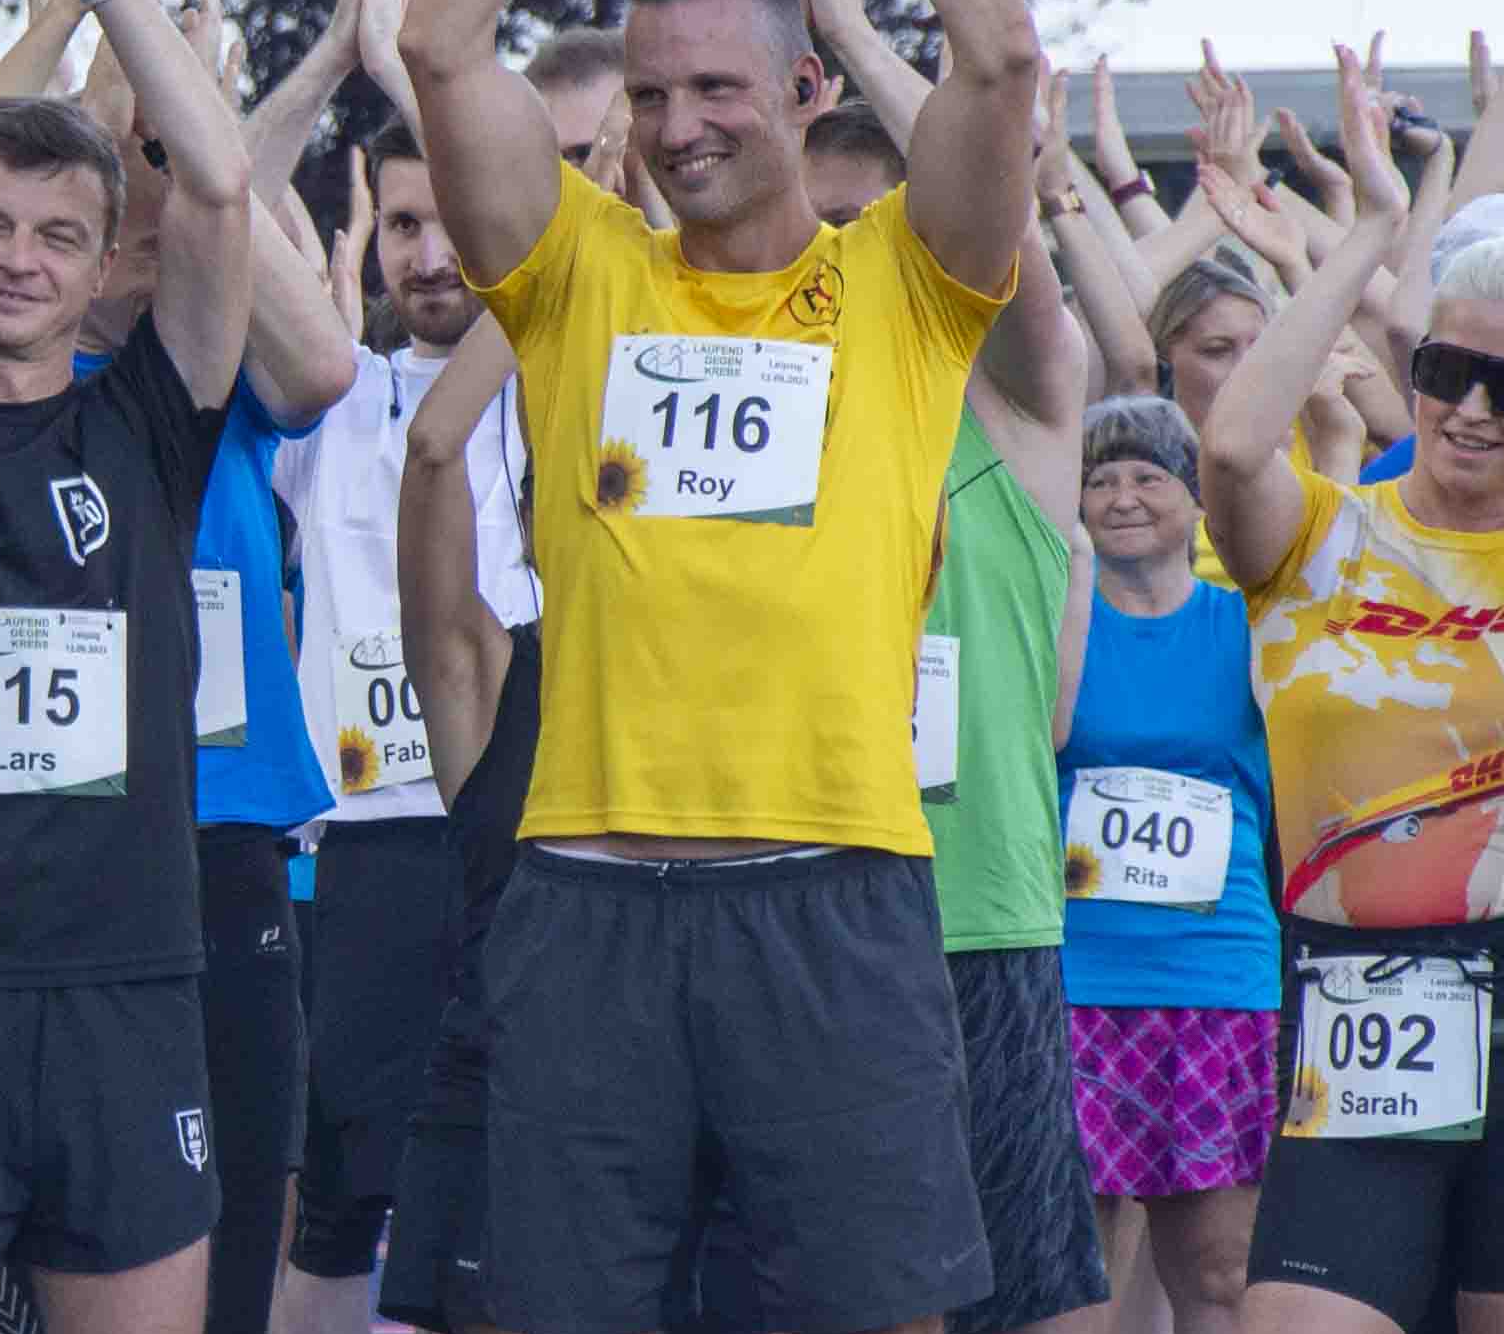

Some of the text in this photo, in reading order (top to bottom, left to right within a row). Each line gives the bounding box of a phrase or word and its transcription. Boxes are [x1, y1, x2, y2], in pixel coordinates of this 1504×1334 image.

[652, 391, 771, 453] 116
[676, 470, 736, 502] Roy
[368, 677, 426, 728] 00
[383, 740, 427, 766] Fab
[1101, 807, 1194, 859] 040
[1124, 866, 1169, 889] Rita
[1329, 1012, 1436, 1072] 092
[1340, 1090, 1418, 1116] Sarah
